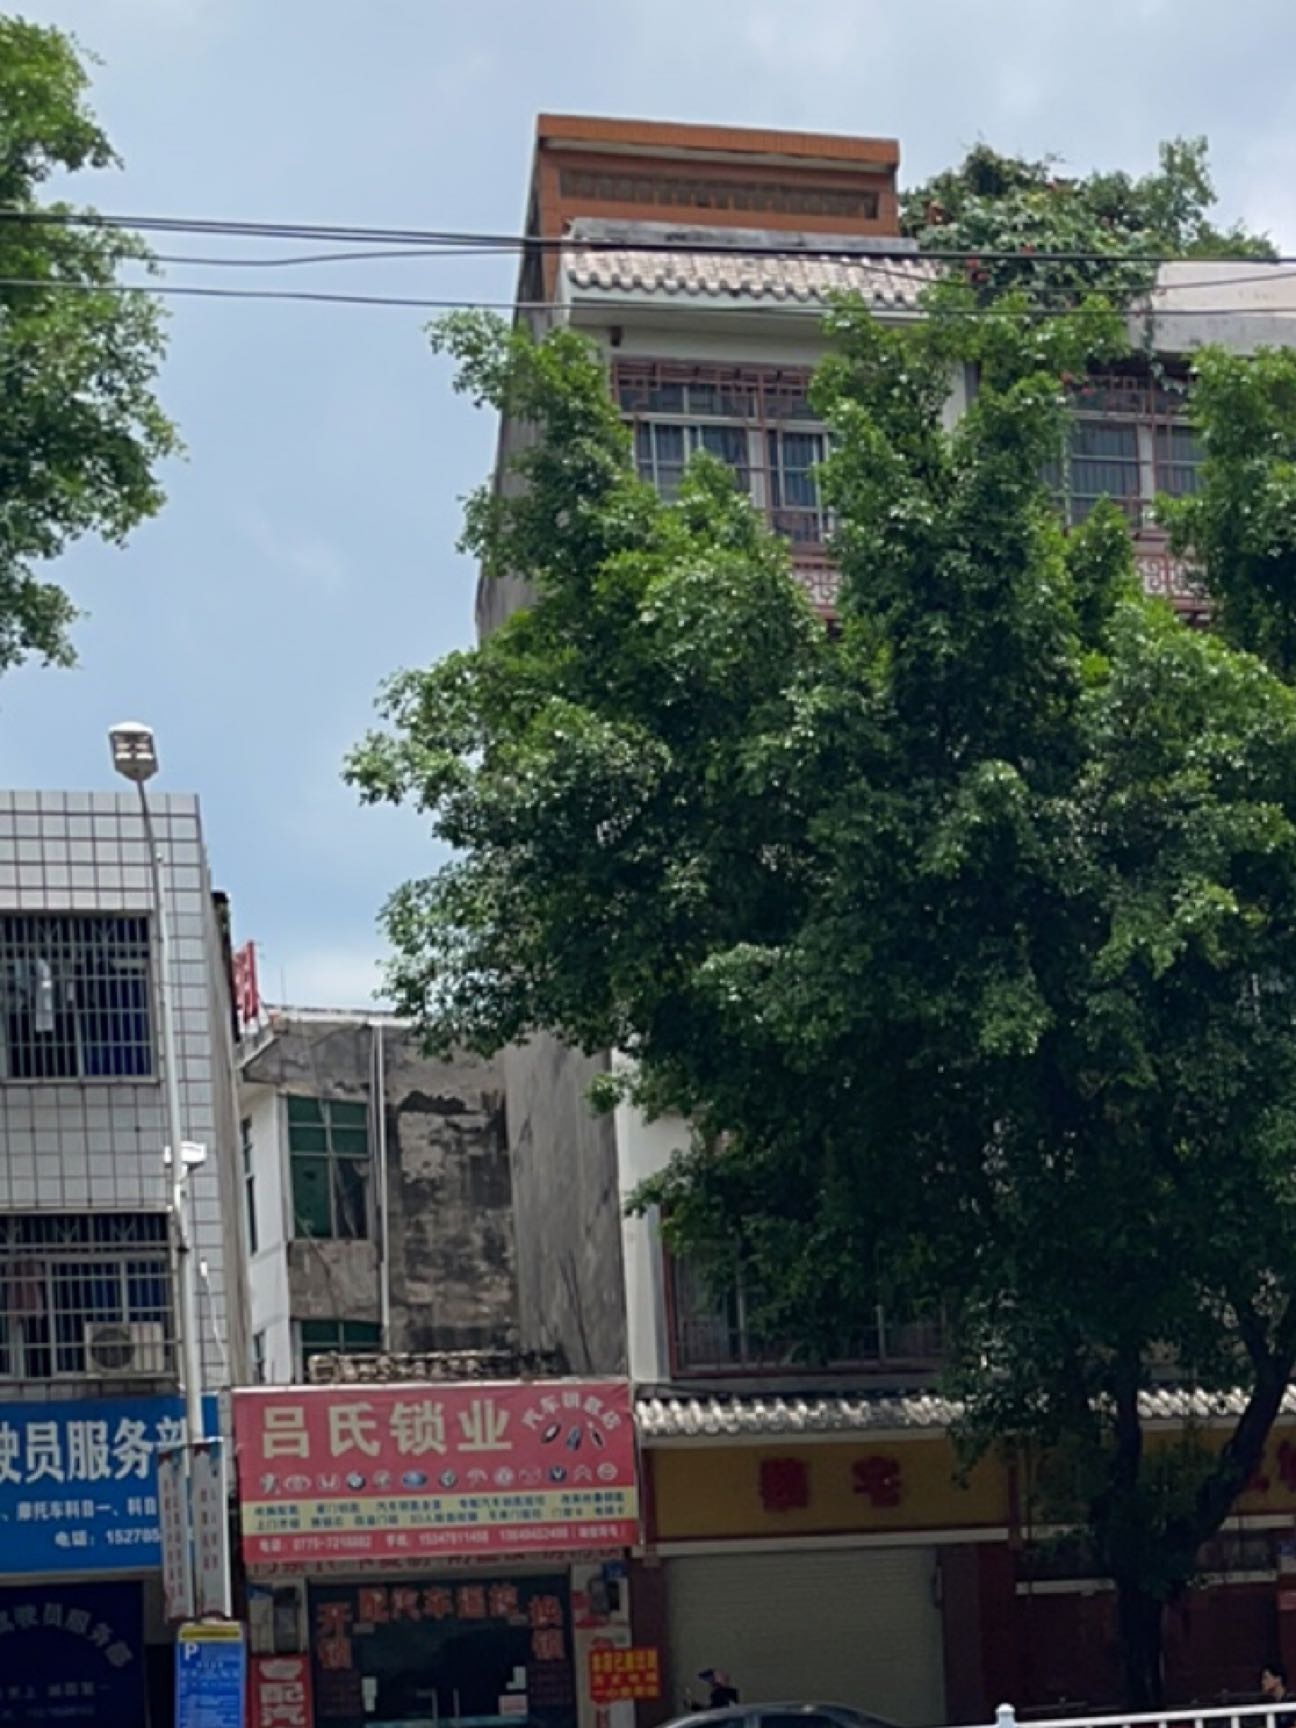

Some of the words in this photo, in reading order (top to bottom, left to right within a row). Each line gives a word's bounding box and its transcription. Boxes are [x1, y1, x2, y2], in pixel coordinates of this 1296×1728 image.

[263, 1399, 513, 1459] 吕氏锁业
[184, 1642, 198, 1660] P
